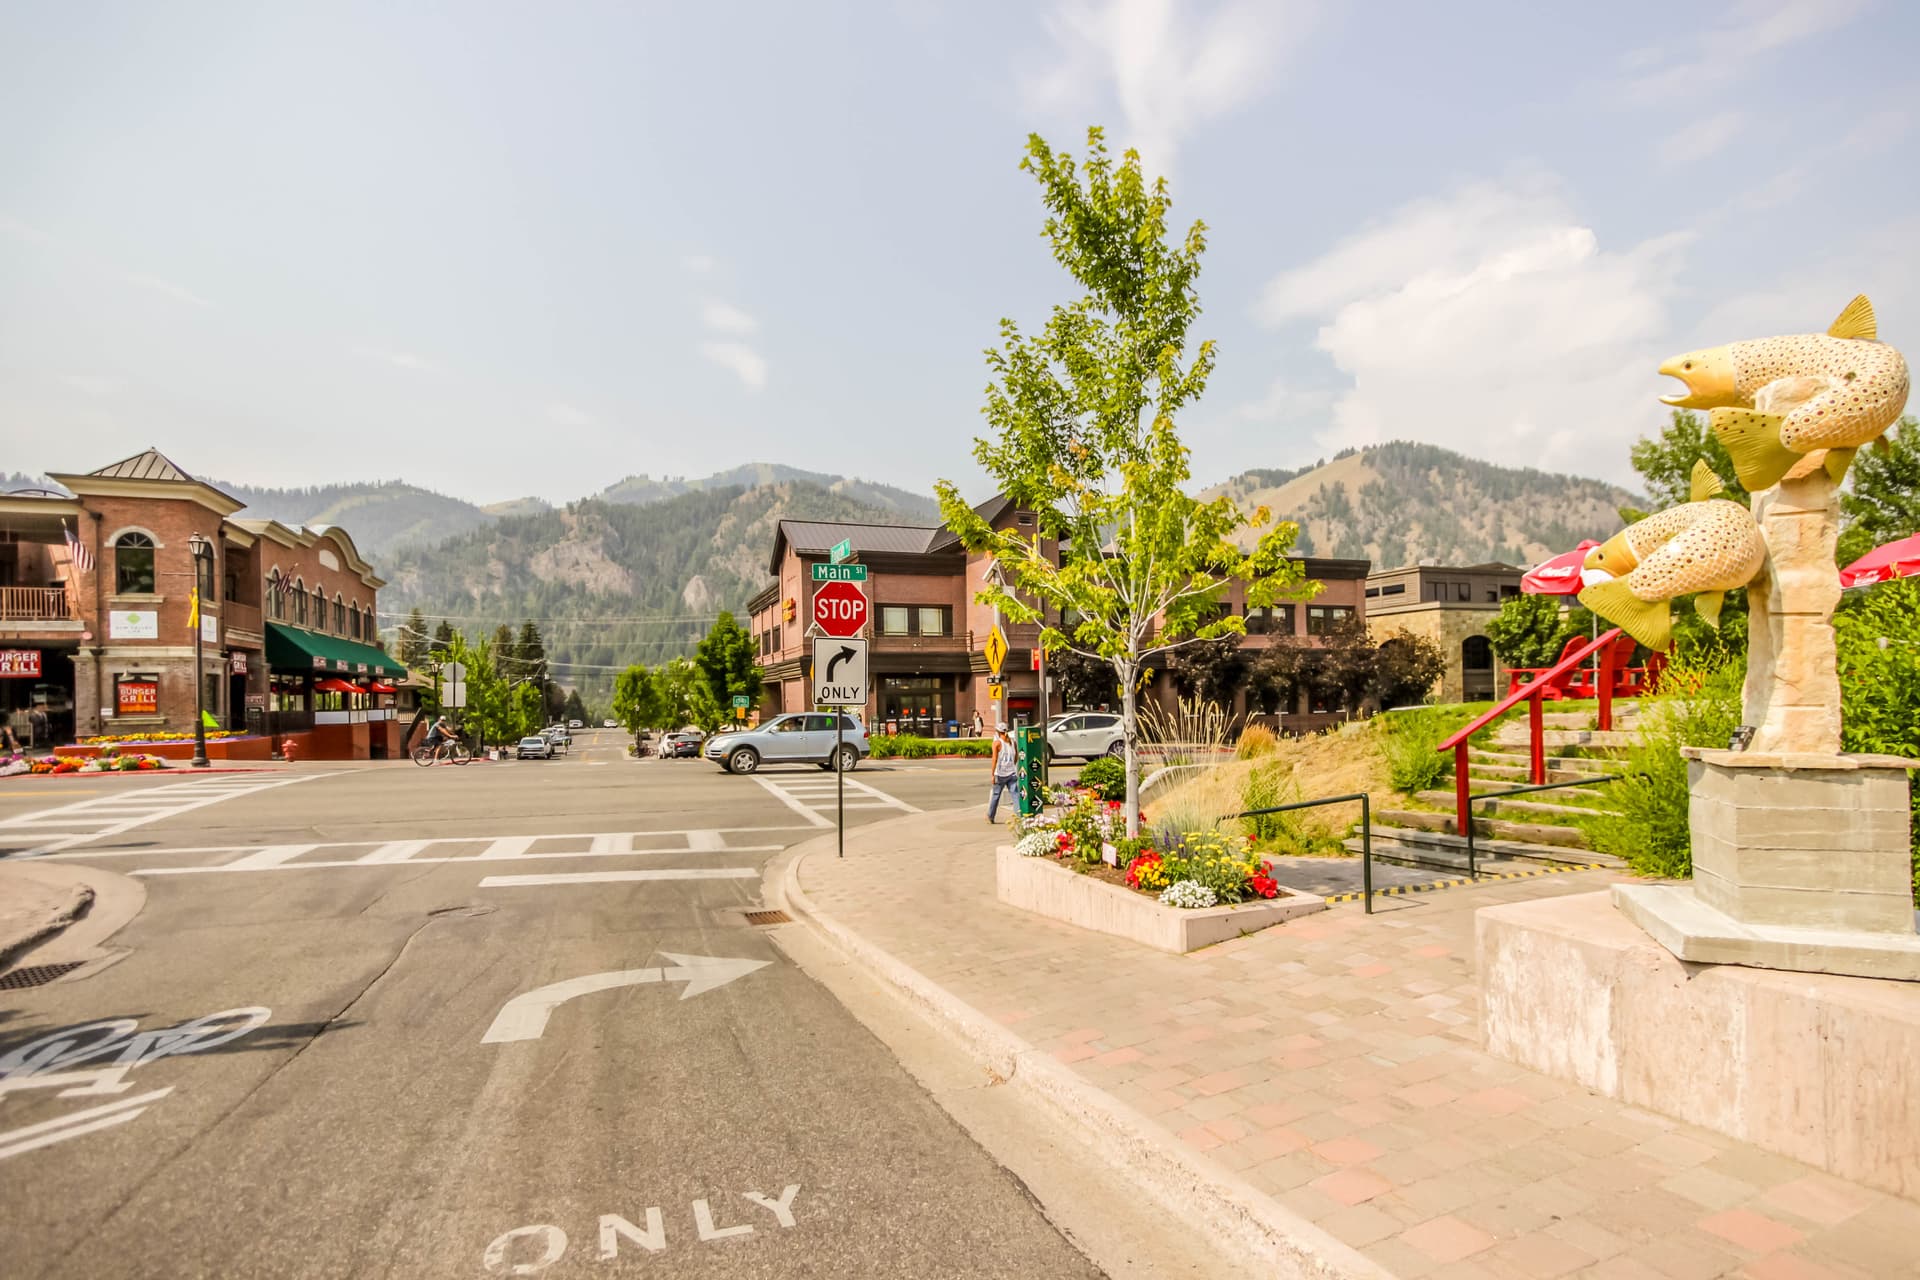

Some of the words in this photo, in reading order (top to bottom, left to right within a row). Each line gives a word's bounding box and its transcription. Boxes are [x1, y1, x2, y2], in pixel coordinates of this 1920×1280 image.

[818, 566, 850, 579] Main
[855, 566, 863, 574] St
[817, 598, 864, 620] STOP
[0, 652, 38, 661] URGER
[0, 661, 39, 672] RILL
[120, 695, 156, 703] GRILL
[822, 686, 859, 699] ONLY
[484, 1184, 801, 1274] ONLY
